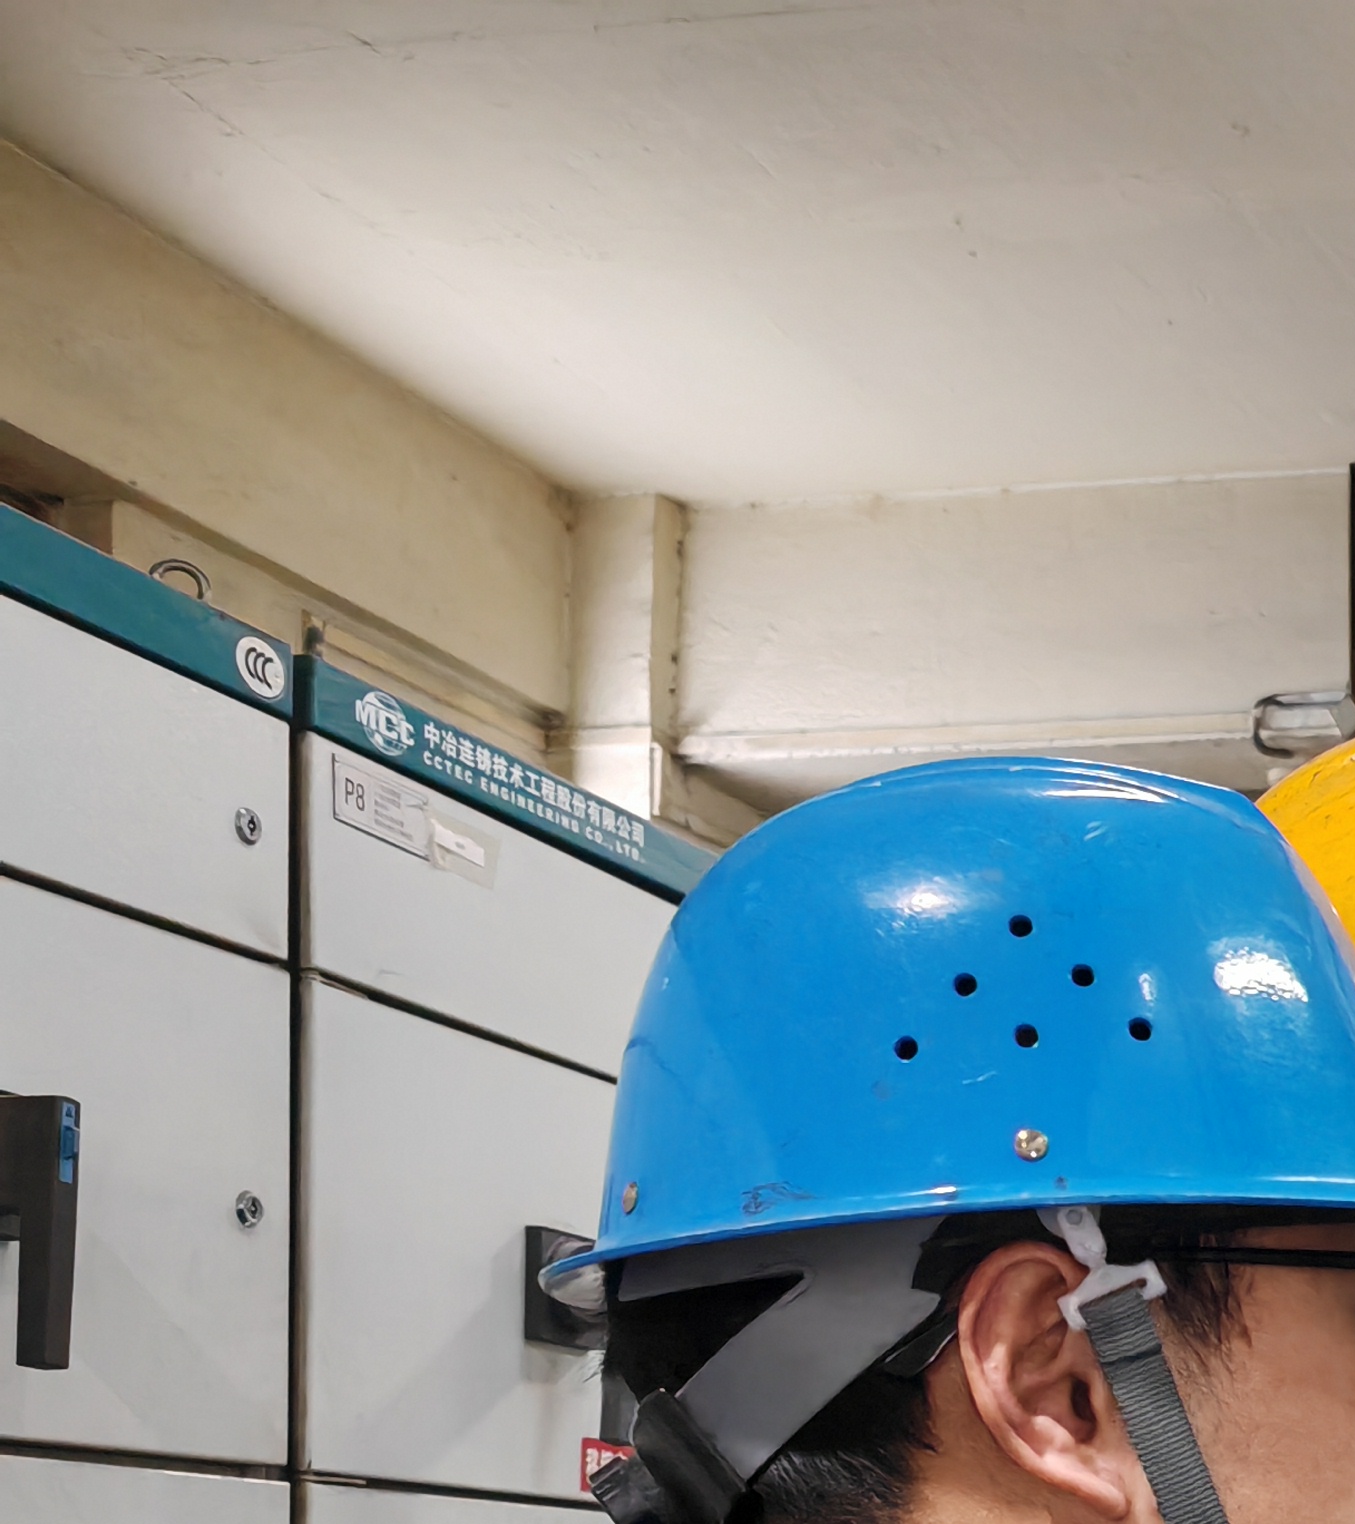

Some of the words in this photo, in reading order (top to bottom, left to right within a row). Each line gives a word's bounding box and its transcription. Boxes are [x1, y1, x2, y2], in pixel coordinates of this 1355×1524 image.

[355, 699, 416, 747] MCC
[345, 777, 365, 812] P8
[422, 721, 645, 848] 中冶连铸技术工程股份有限公司
[422, 750, 474, 785] CCTEC
[480, 778, 580, 834] ENGINEERING
